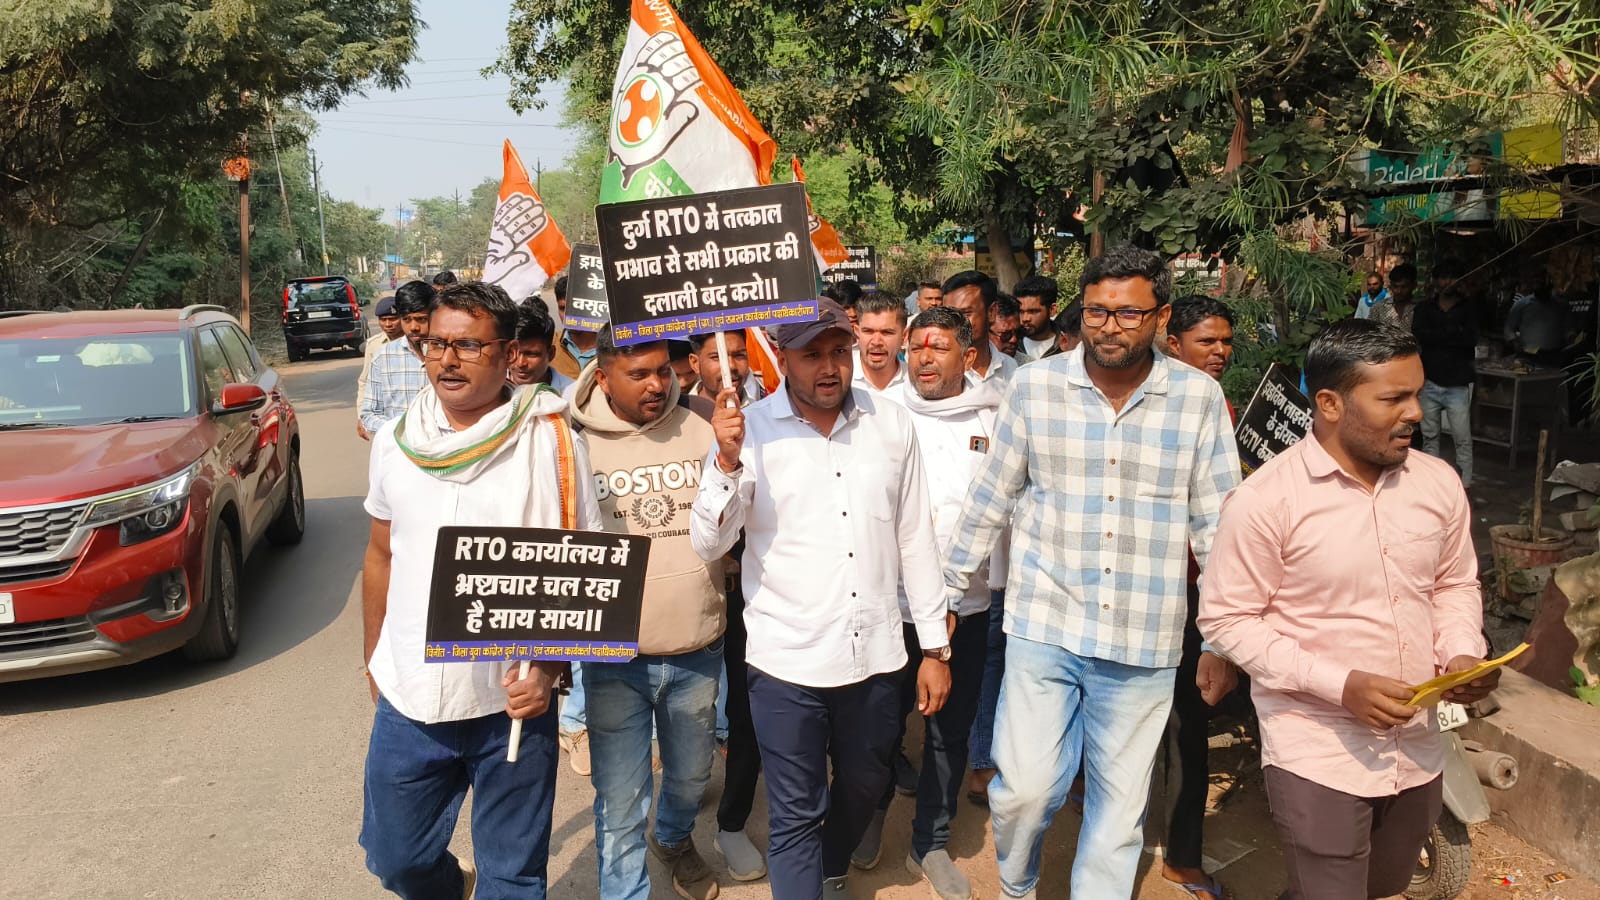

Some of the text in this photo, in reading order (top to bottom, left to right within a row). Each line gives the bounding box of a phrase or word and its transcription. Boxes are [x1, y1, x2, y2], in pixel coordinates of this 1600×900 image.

[621, 203, 782, 250] दुर्ग RTO में तत्काल
[614, 232, 799, 281] प्रभाव से सभी प्रकार की
[587, 272, 605, 290] के
[643, 281, 698, 316] दलाली
[700, 278, 728, 307] बंद
[1266, 410, 1278, 431] के
[1240, 423, 1262, 453] CCTV
[593, 460, 702, 501] BOSTON
[613, 501, 693, 519] EST. 198
[658, 528, 691, 538] COURAGE
[454, 535, 630, 567] RTO कार्यालय में
[542, 576, 579, 597] चल
[584, 577, 621, 601] रहा
[466, 599, 485, 634] है
[489, 608, 536, 630] साय
